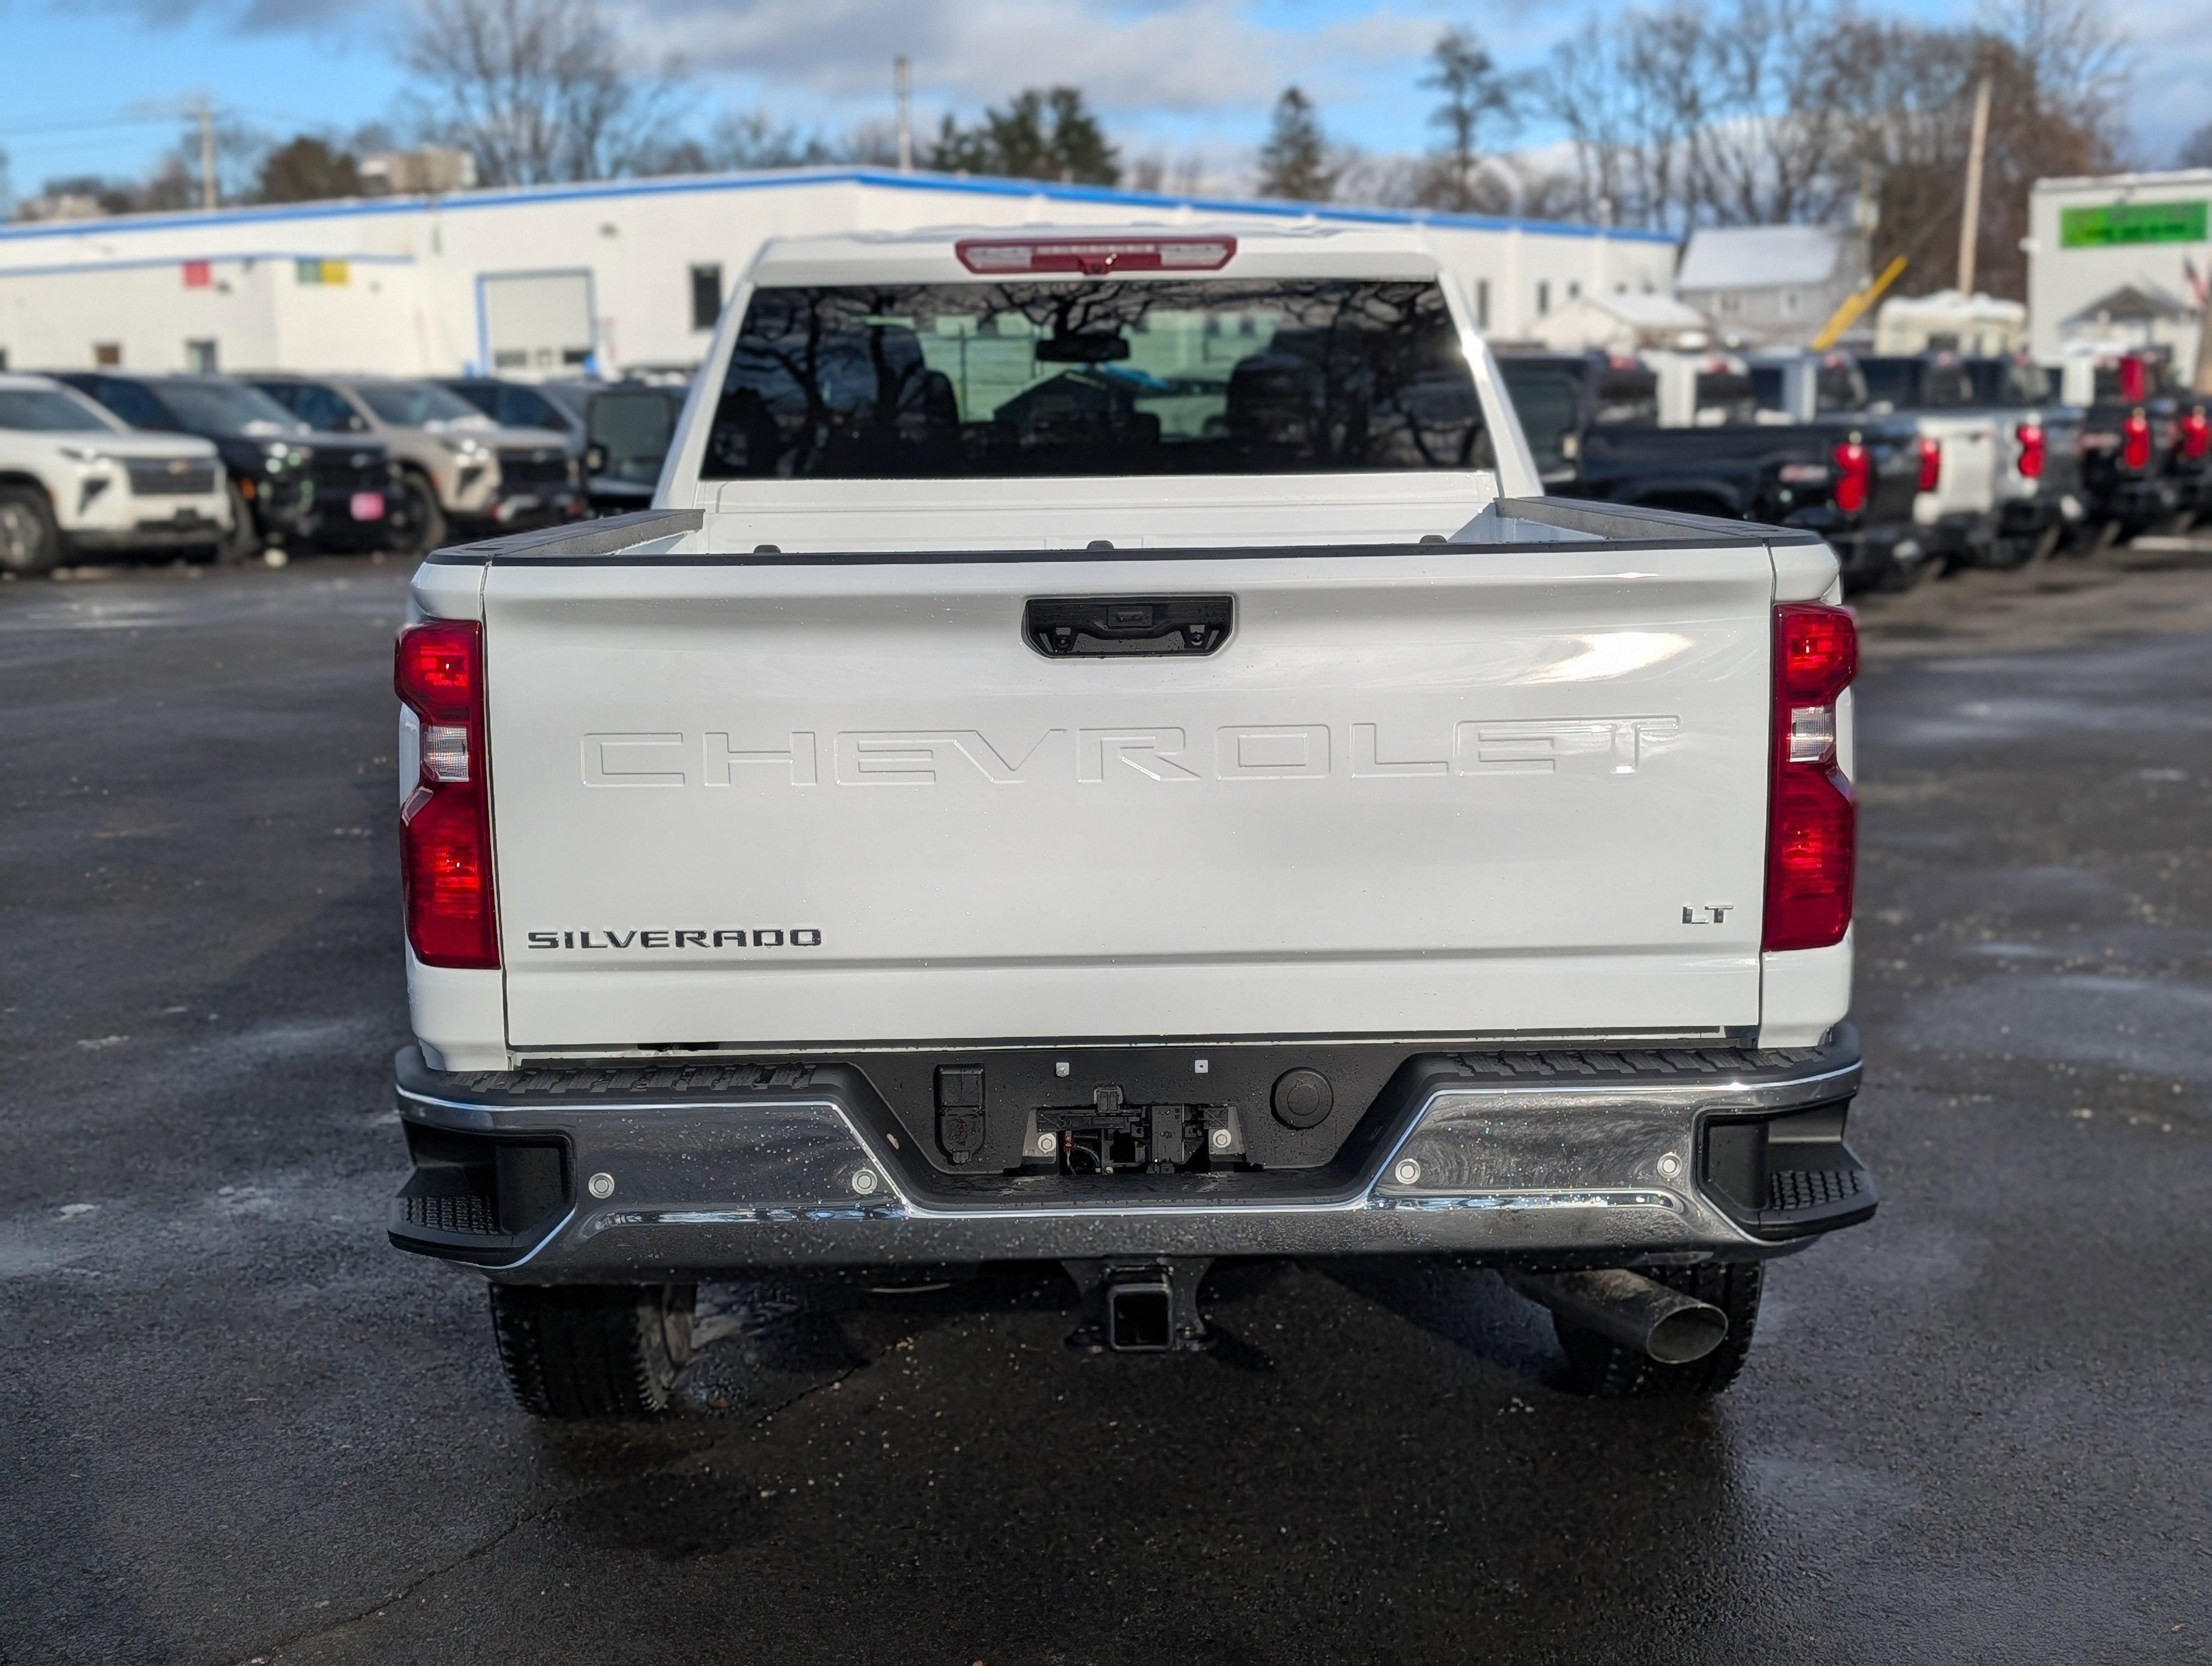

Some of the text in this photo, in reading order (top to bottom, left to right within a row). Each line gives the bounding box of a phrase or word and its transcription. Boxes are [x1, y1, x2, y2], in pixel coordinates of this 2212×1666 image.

[581, 714, 1681, 787] CHEVROLET
[1682, 904, 1734, 924] LT
[528, 928, 822, 949] SILVERADO
